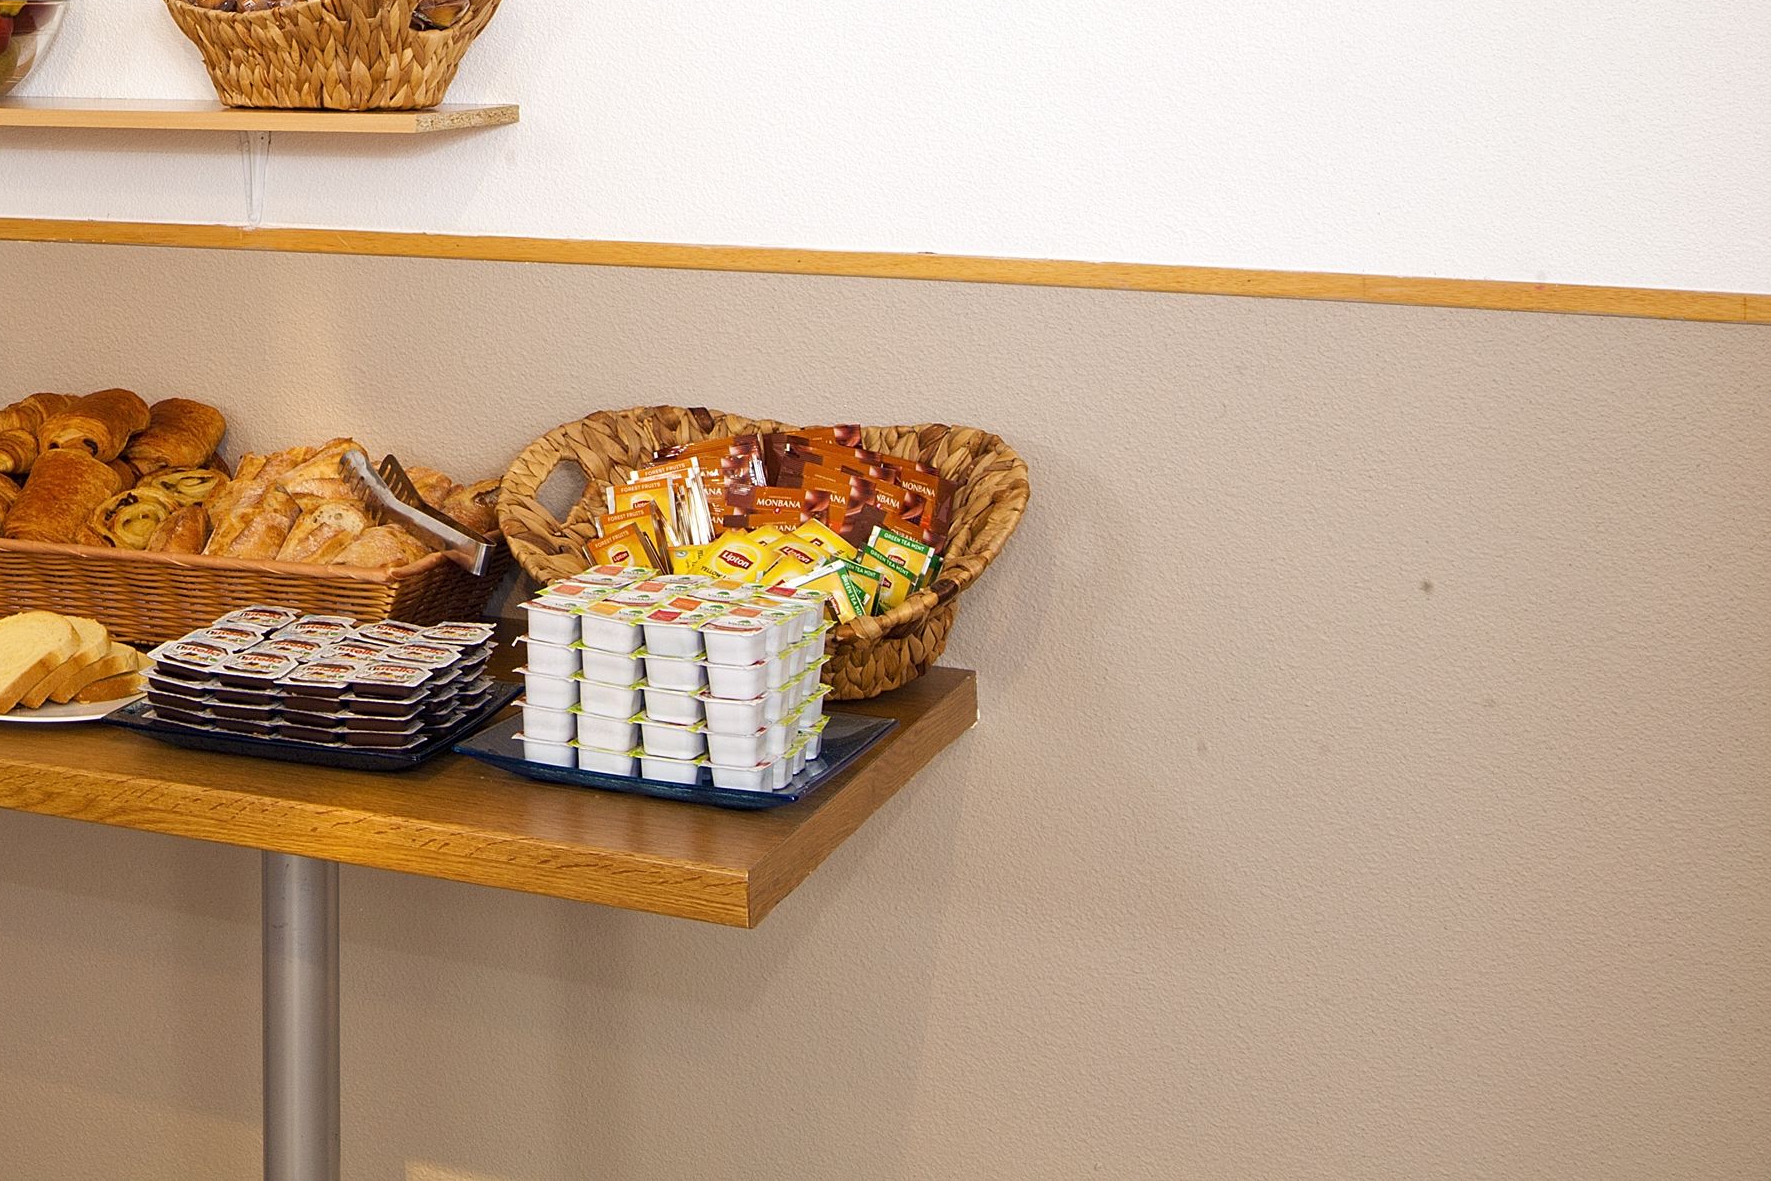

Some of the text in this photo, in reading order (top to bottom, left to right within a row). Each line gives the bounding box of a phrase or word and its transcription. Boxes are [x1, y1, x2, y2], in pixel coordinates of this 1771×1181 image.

[645, 462, 686, 477] FOREST FRUITS
[621, 485, 641, 493] FOREST
[902, 481, 936, 497] MONBANA
[756, 498, 801, 509] MONBANA
[876, 493, 901, 509] NBANA
[608, 509, 645, 521] FOREST FRUITS
[595, 530, 629, 548] FOREST FRUITS
[884, 532, 925, 552] GREEN TEA MINT
[613, 552, 629, 562] Lipton
[722, 550, 750, 569] Lipton
[870, 549, 909, 576] GREEN TEA MINT
[701, 566, 722, 579] YELLOW
[176, 645, 221, 657] nutella
[238, 655, 282, 664] nutella
